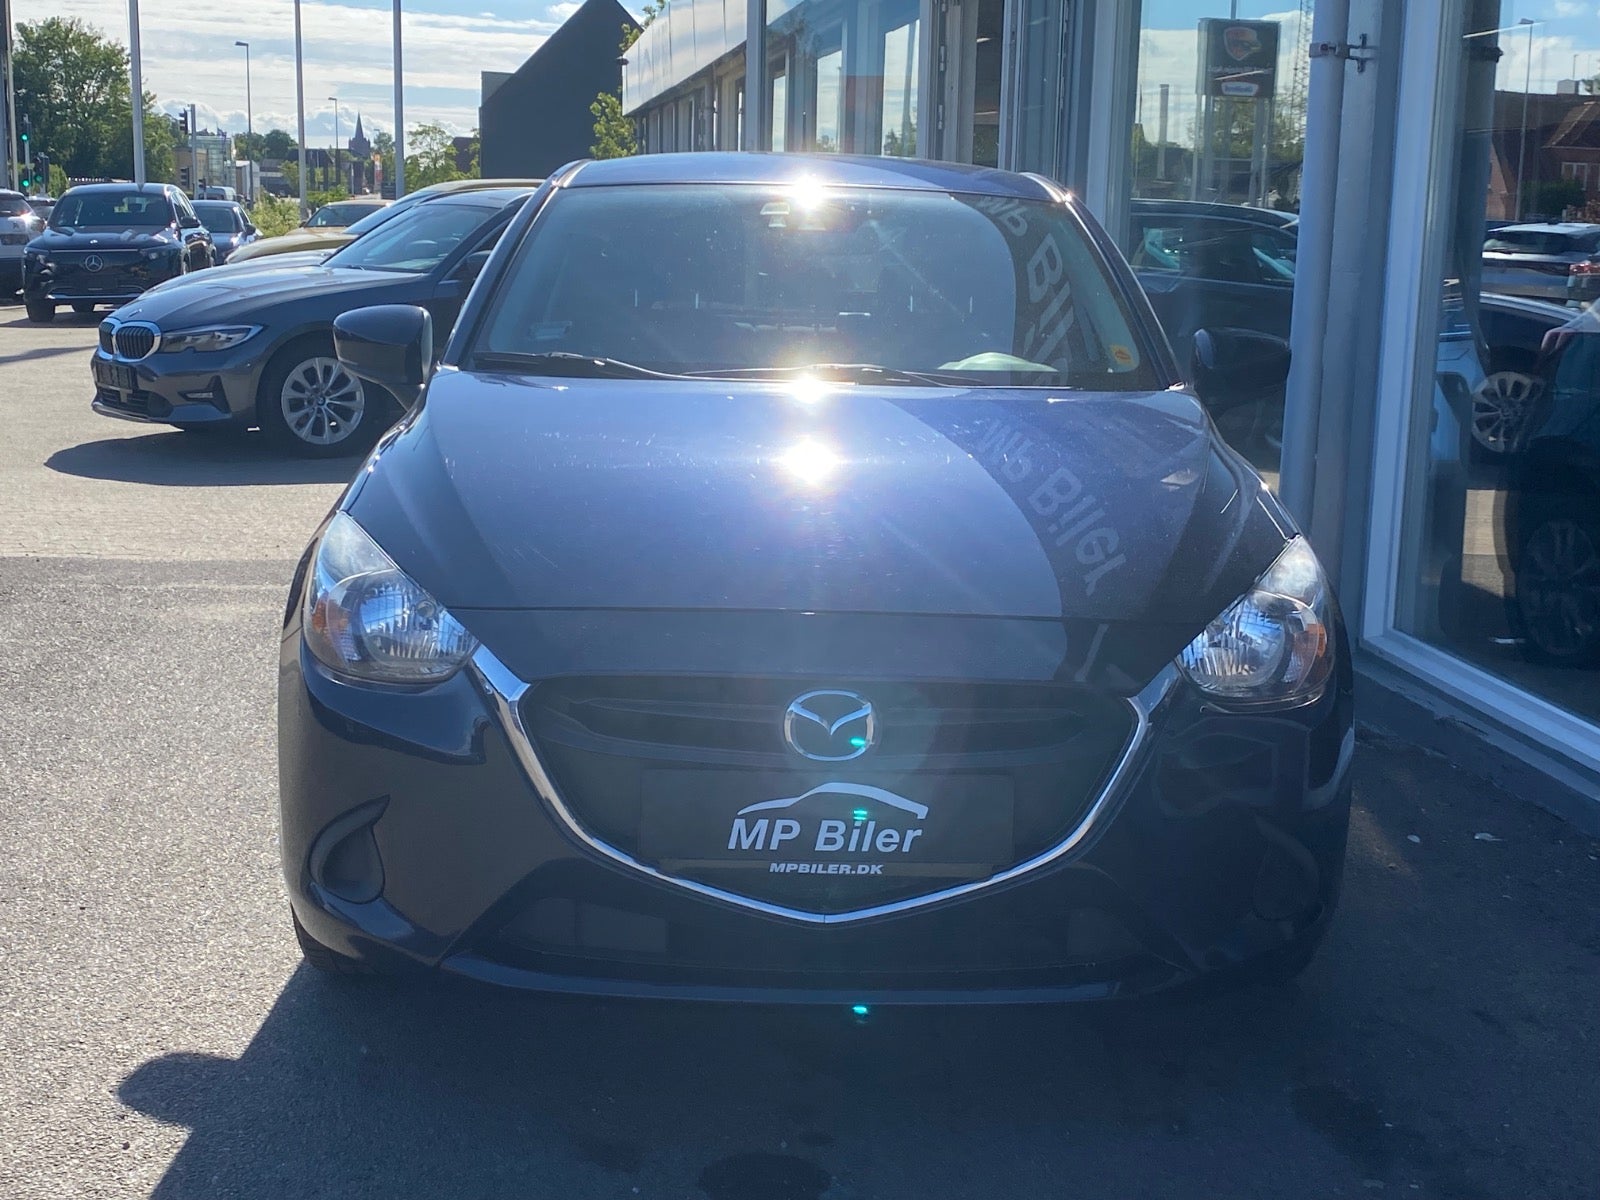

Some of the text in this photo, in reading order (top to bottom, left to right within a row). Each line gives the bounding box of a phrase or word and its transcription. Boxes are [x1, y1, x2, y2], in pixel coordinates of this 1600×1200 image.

[727, 818, 922, 853] MP Biler
[769, 862, 884, 875] MPBILER.DK
